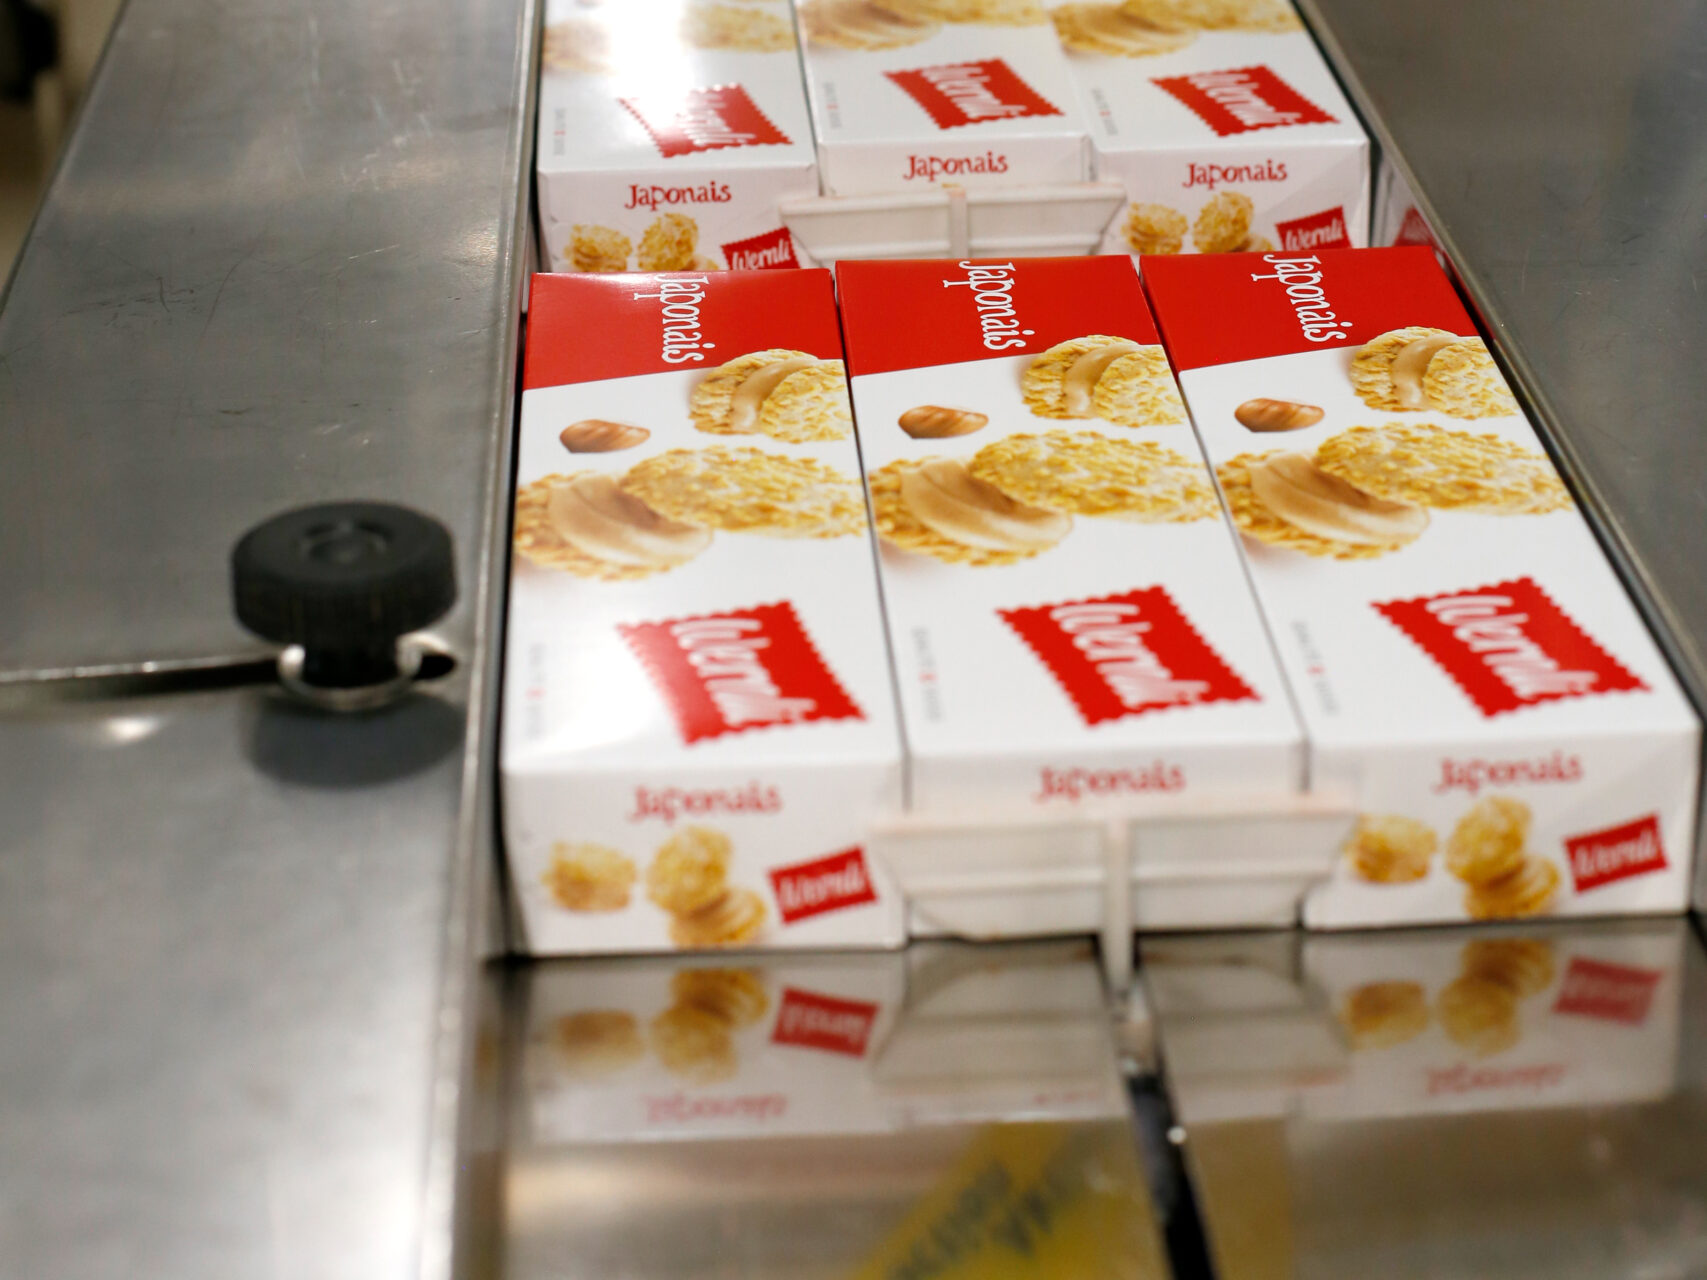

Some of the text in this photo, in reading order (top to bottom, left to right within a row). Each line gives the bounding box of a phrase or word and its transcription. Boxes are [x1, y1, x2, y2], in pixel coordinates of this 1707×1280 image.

[624, 180, 732, 211] Japonais
[902, 151, 1009, 182] Japonais
[1182, 158, 1288, 190] Japonais
[633, 273, 716, 364] Japonais
[942, 260, 1036, 350] Japonais
[1250, 254, 1353, 342] Japonais
[670, 617, 817, 728] Wernli
[1050, 602, 1210, 711] Wernli
[1424, 594, 1598, 701] Wernli
